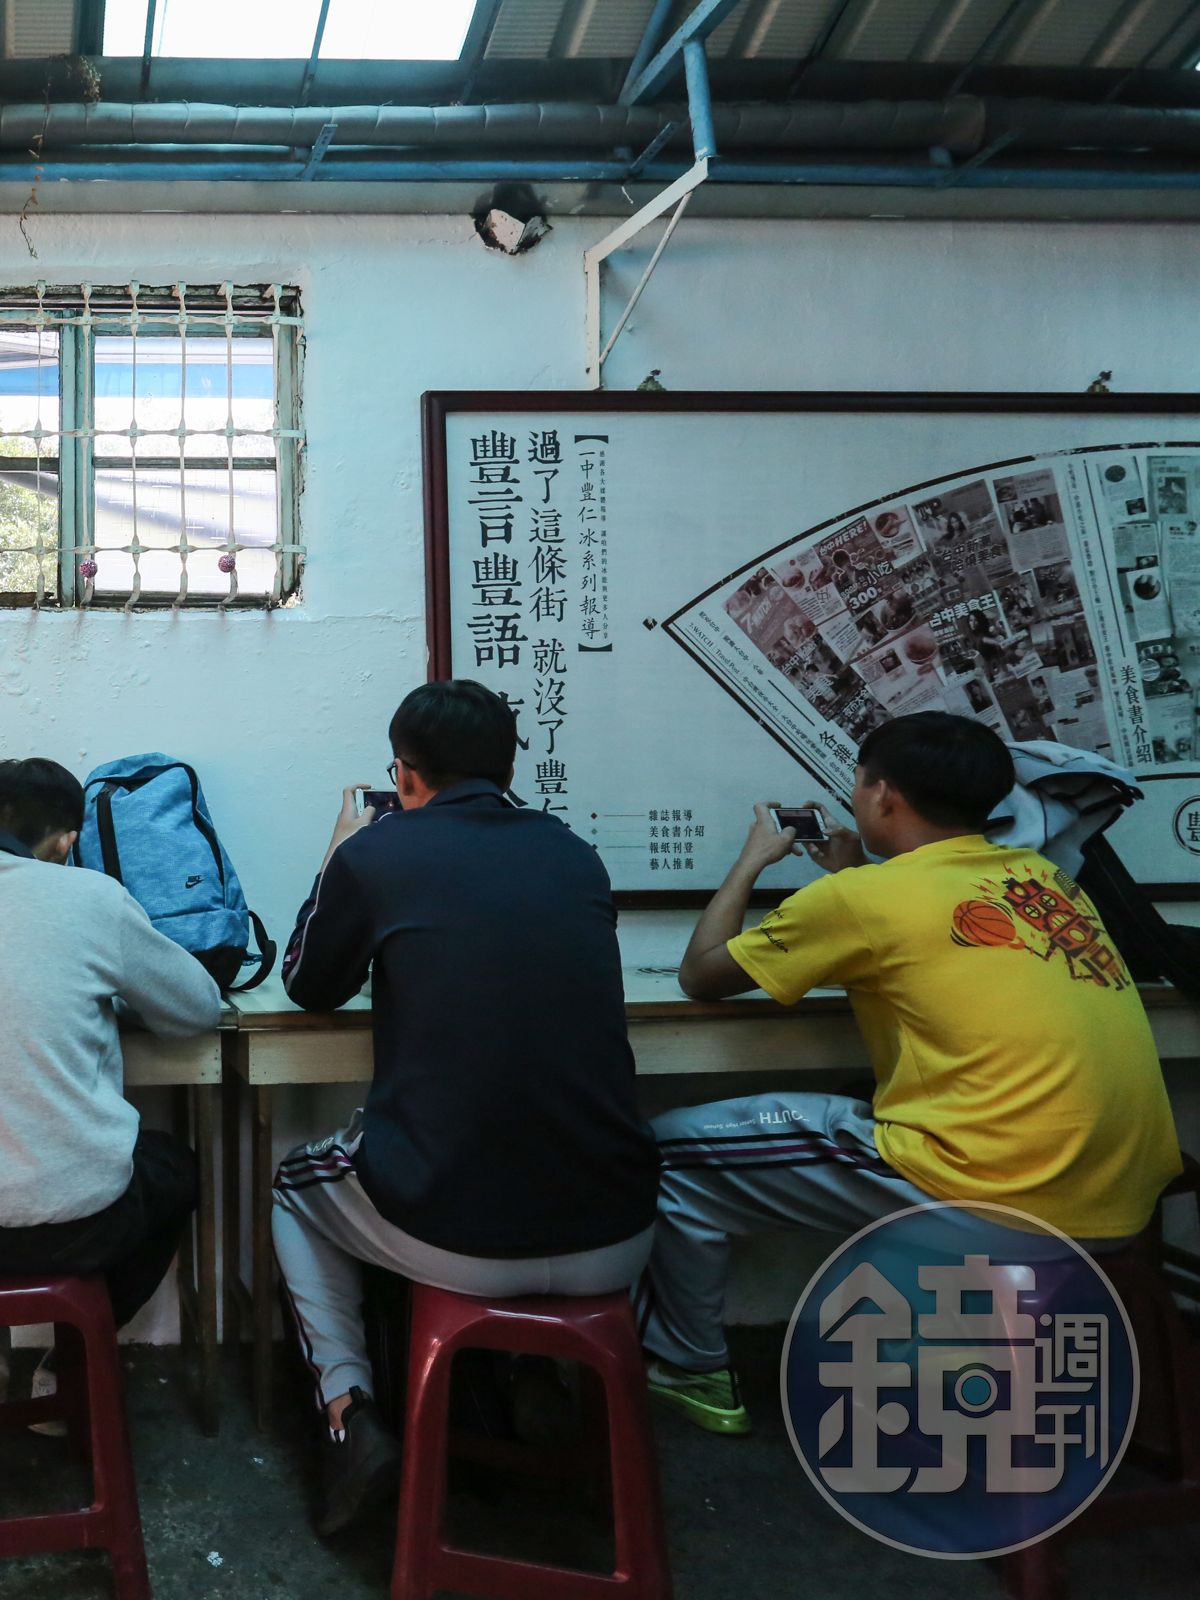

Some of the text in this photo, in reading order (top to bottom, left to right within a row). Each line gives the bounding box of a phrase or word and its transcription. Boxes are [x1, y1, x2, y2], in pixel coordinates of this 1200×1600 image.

[528, 430, 568, 622] 過了這條街
[468, 430, 528, 668] 豐言豐語
[867, 561, 893, 586] 小吃
[929, 593, 997, 628] 台中美食王
[1120, 665, 1153, 764] 美食書介紹
[648, 809, 693, 822] 雜誌報導
[649, 825, 705, 838] 美食書介紹
[649, 842, 694, 854] 報紙刊登
[650, 858, 694, 870] 藝人推薦
[759, 1109, 810, 1125] OUTH
